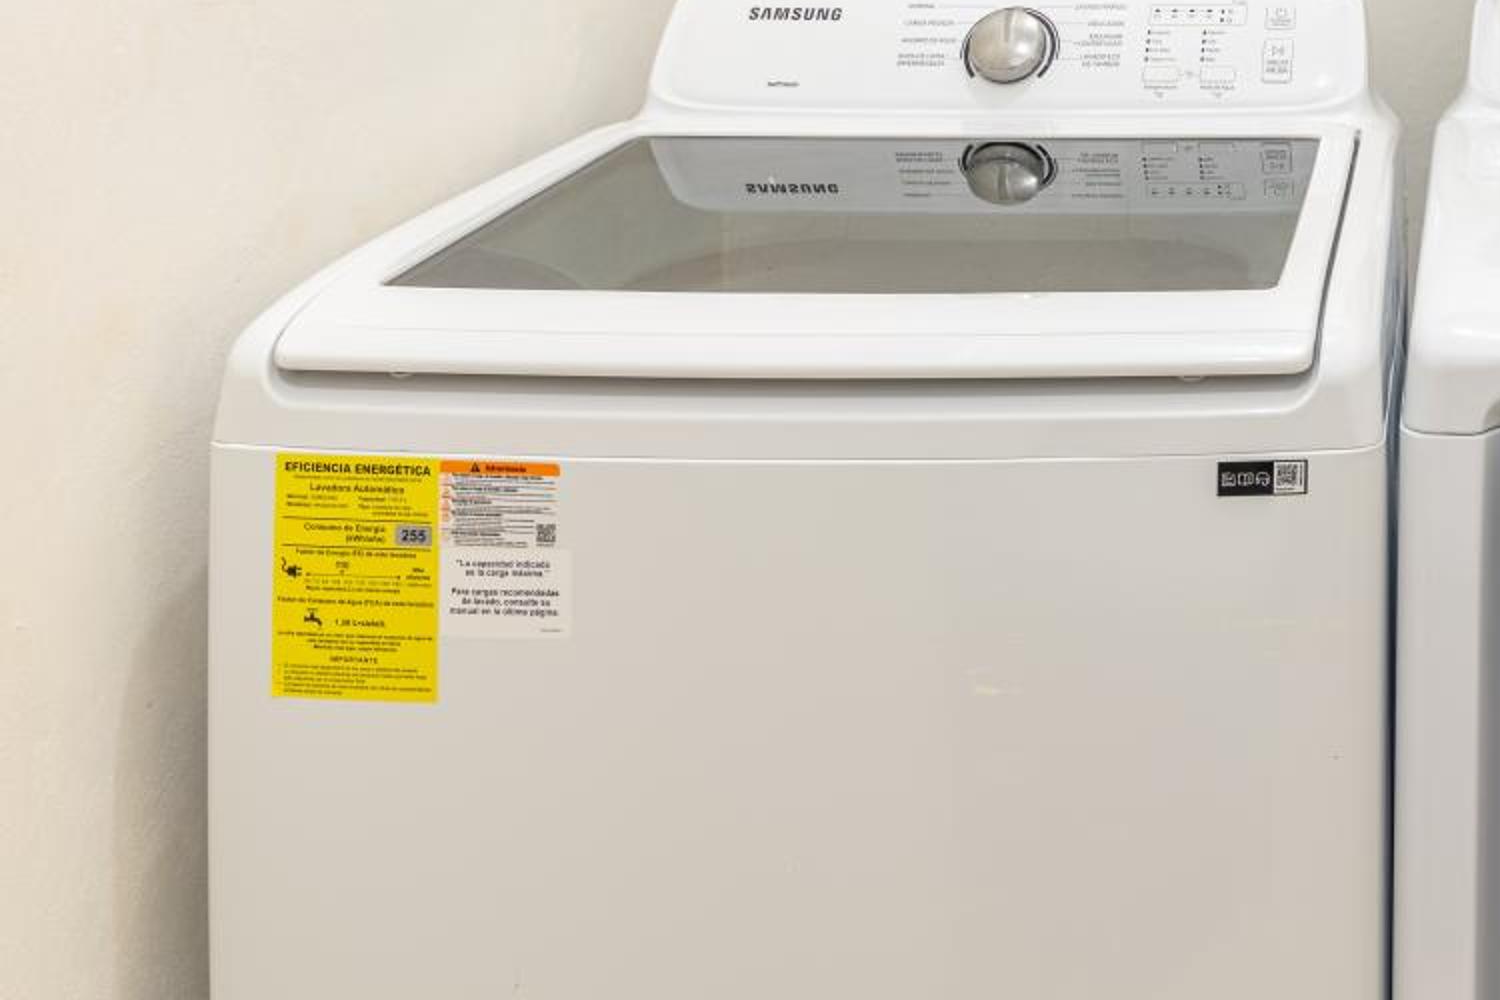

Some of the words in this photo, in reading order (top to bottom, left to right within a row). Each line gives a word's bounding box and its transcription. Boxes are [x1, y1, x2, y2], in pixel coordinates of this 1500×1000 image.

[749, 7, 843, 21] SAMSUNG
[285, 461, 351, 474] EFICIENCIA
[354, 462, 431, 476] ENERGÉTICA
[401, 529, 427, 543] 255
